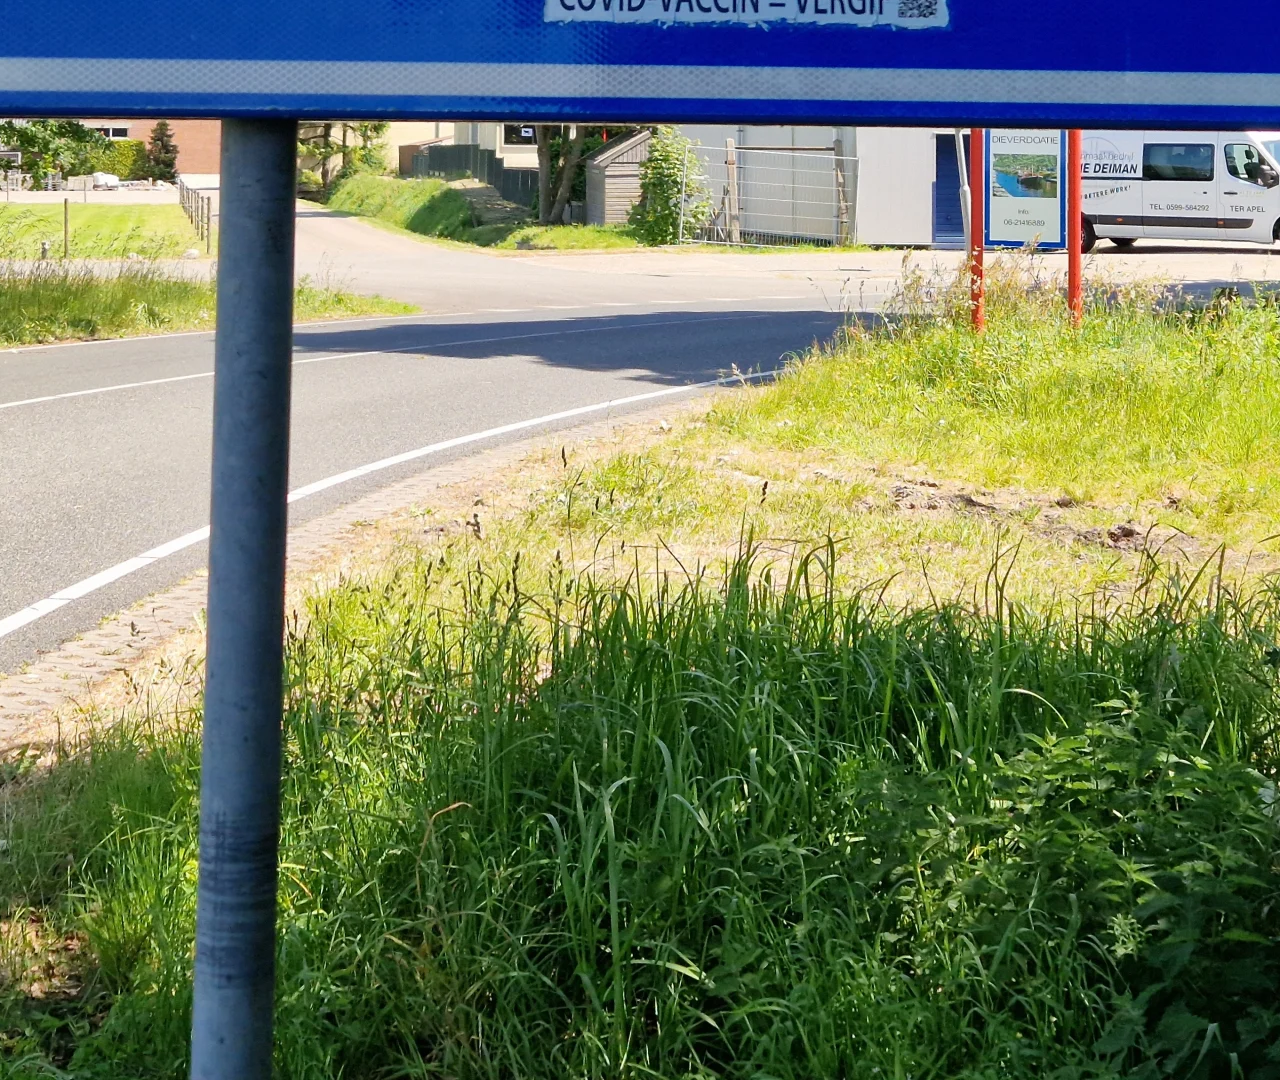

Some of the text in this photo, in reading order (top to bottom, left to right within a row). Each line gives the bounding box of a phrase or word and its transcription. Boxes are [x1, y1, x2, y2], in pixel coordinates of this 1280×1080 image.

[1093, 163, 1138, 174] DEIMAN
[1230, 205, 1266, 213] TER APEL
